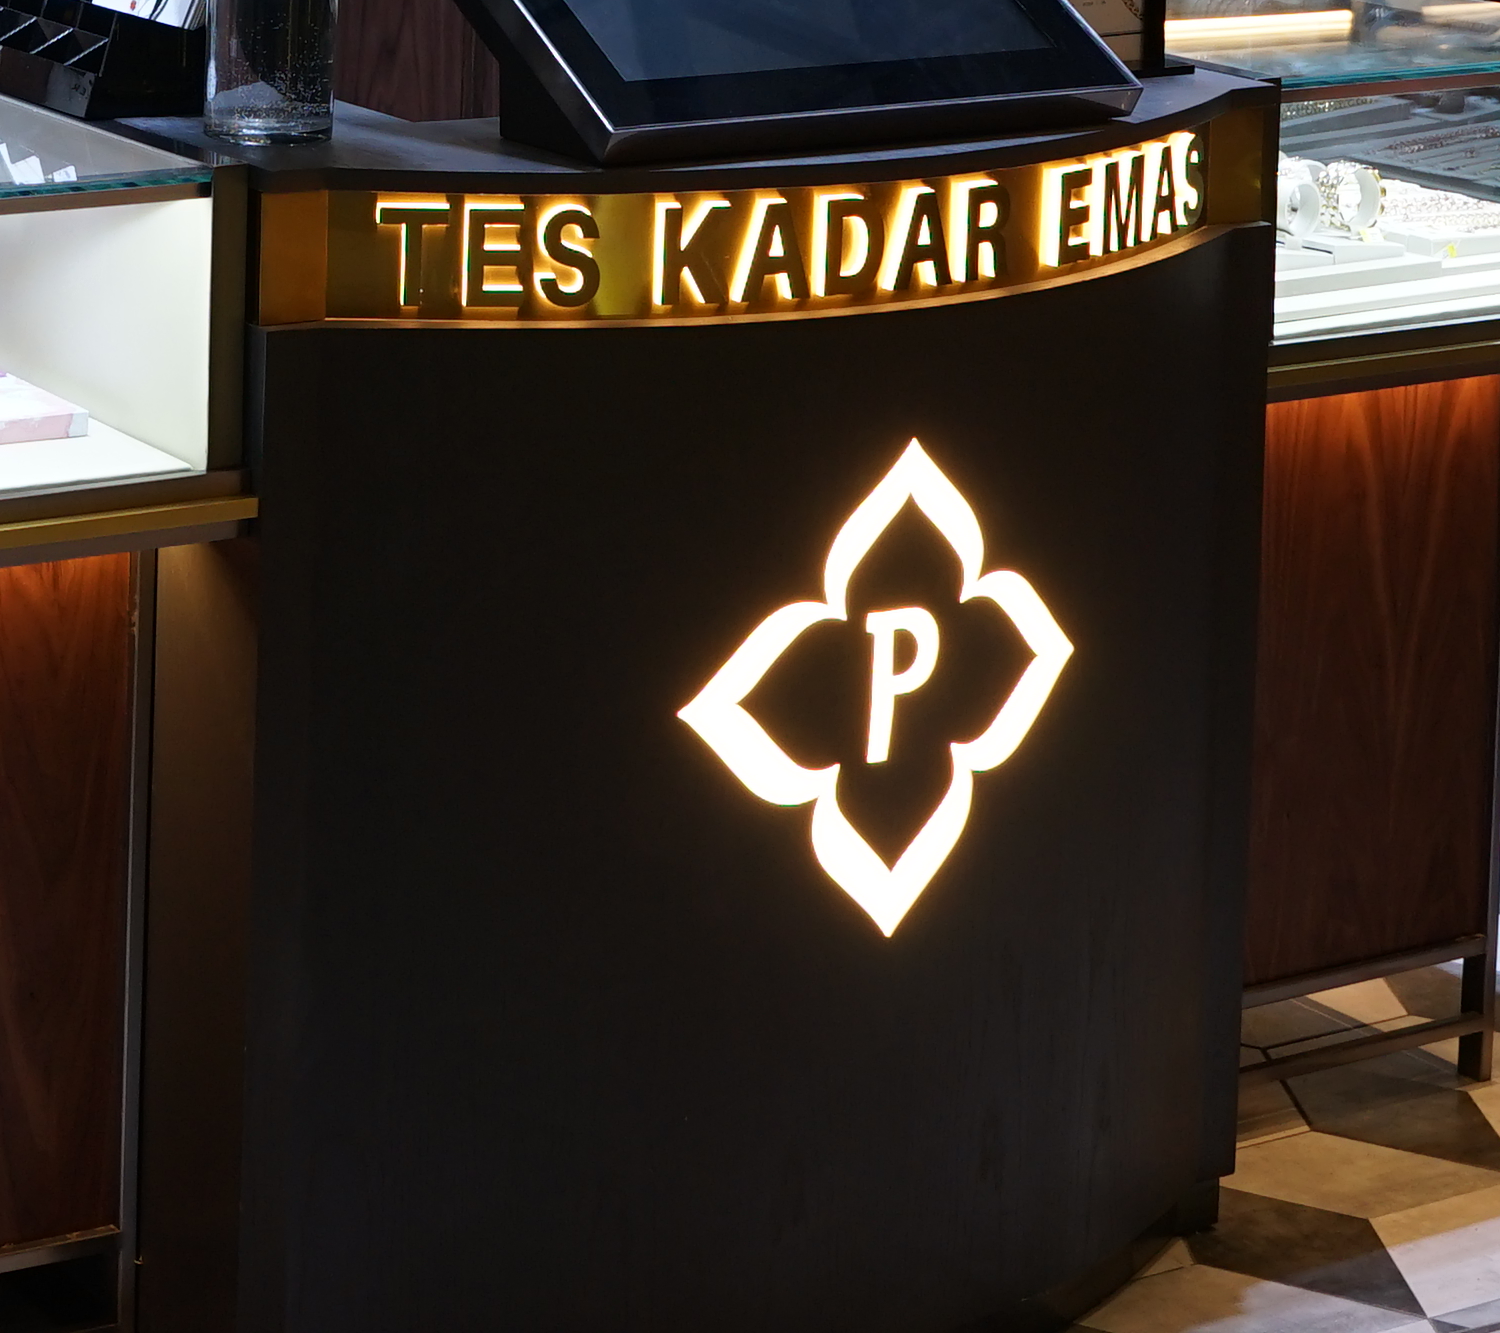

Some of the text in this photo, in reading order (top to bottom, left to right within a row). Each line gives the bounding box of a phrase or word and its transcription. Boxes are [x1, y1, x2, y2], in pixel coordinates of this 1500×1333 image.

[375, 129, 1204, 309] TES KADAR EMAS
[864, 605, 941, 764] P
